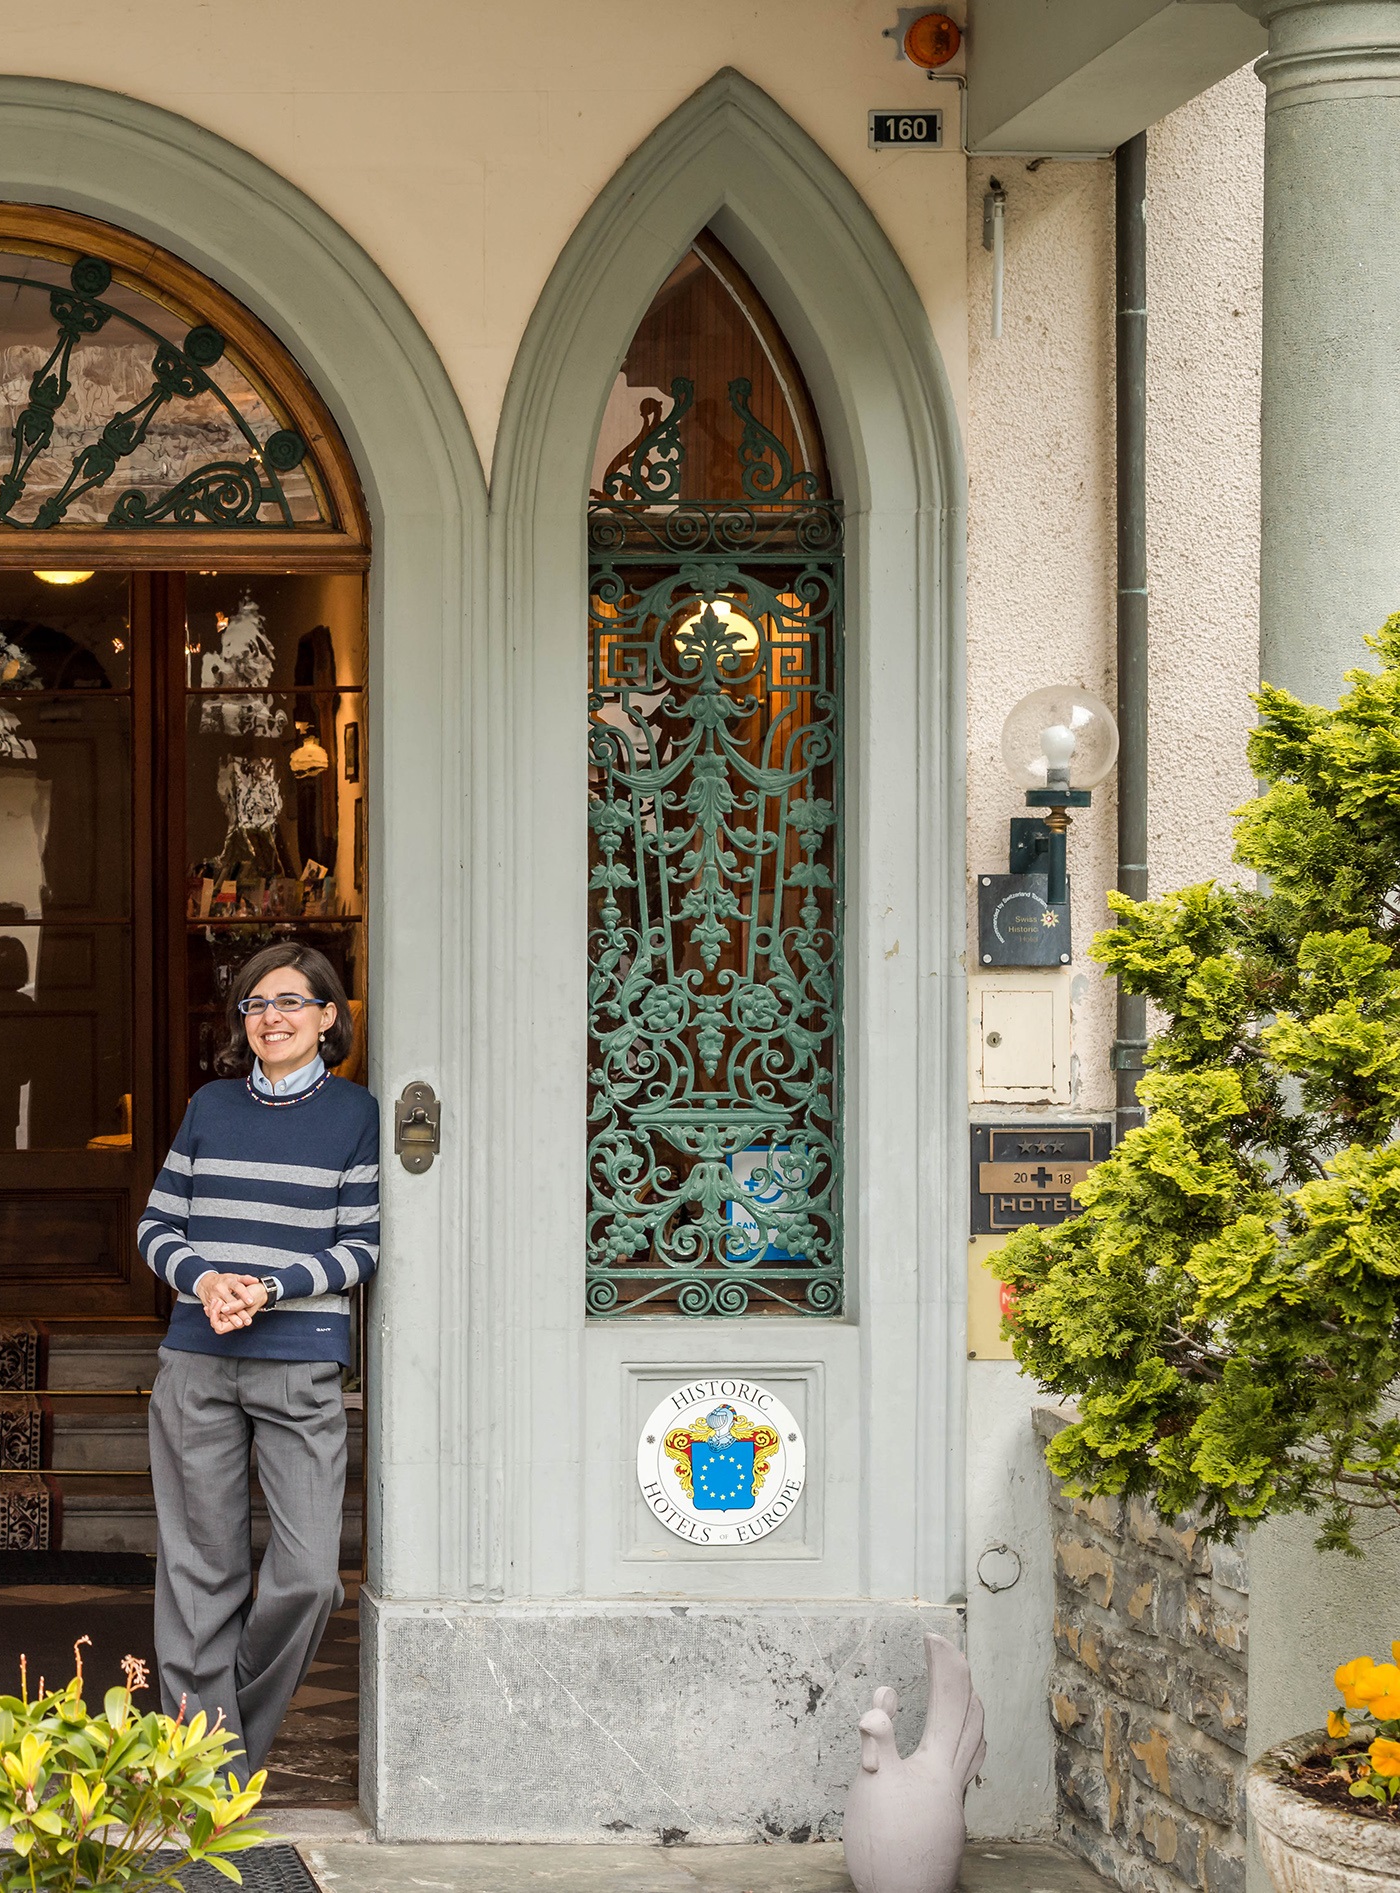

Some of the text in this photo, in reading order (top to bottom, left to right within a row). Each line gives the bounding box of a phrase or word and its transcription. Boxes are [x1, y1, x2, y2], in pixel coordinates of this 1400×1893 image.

[886, 118, 927, 140] 160
[1015, 915, 1038, 923] Swiss
[1013, 1172, 1072, 1185] 20 18
[1000, 1197, 1084, 1212] HOTEL
[671, 1380, 774, 1411] HISTORIC
[644, 1481, 712, 1543] HOTELS
[736, 1479, 801, 1542] EUROPE
